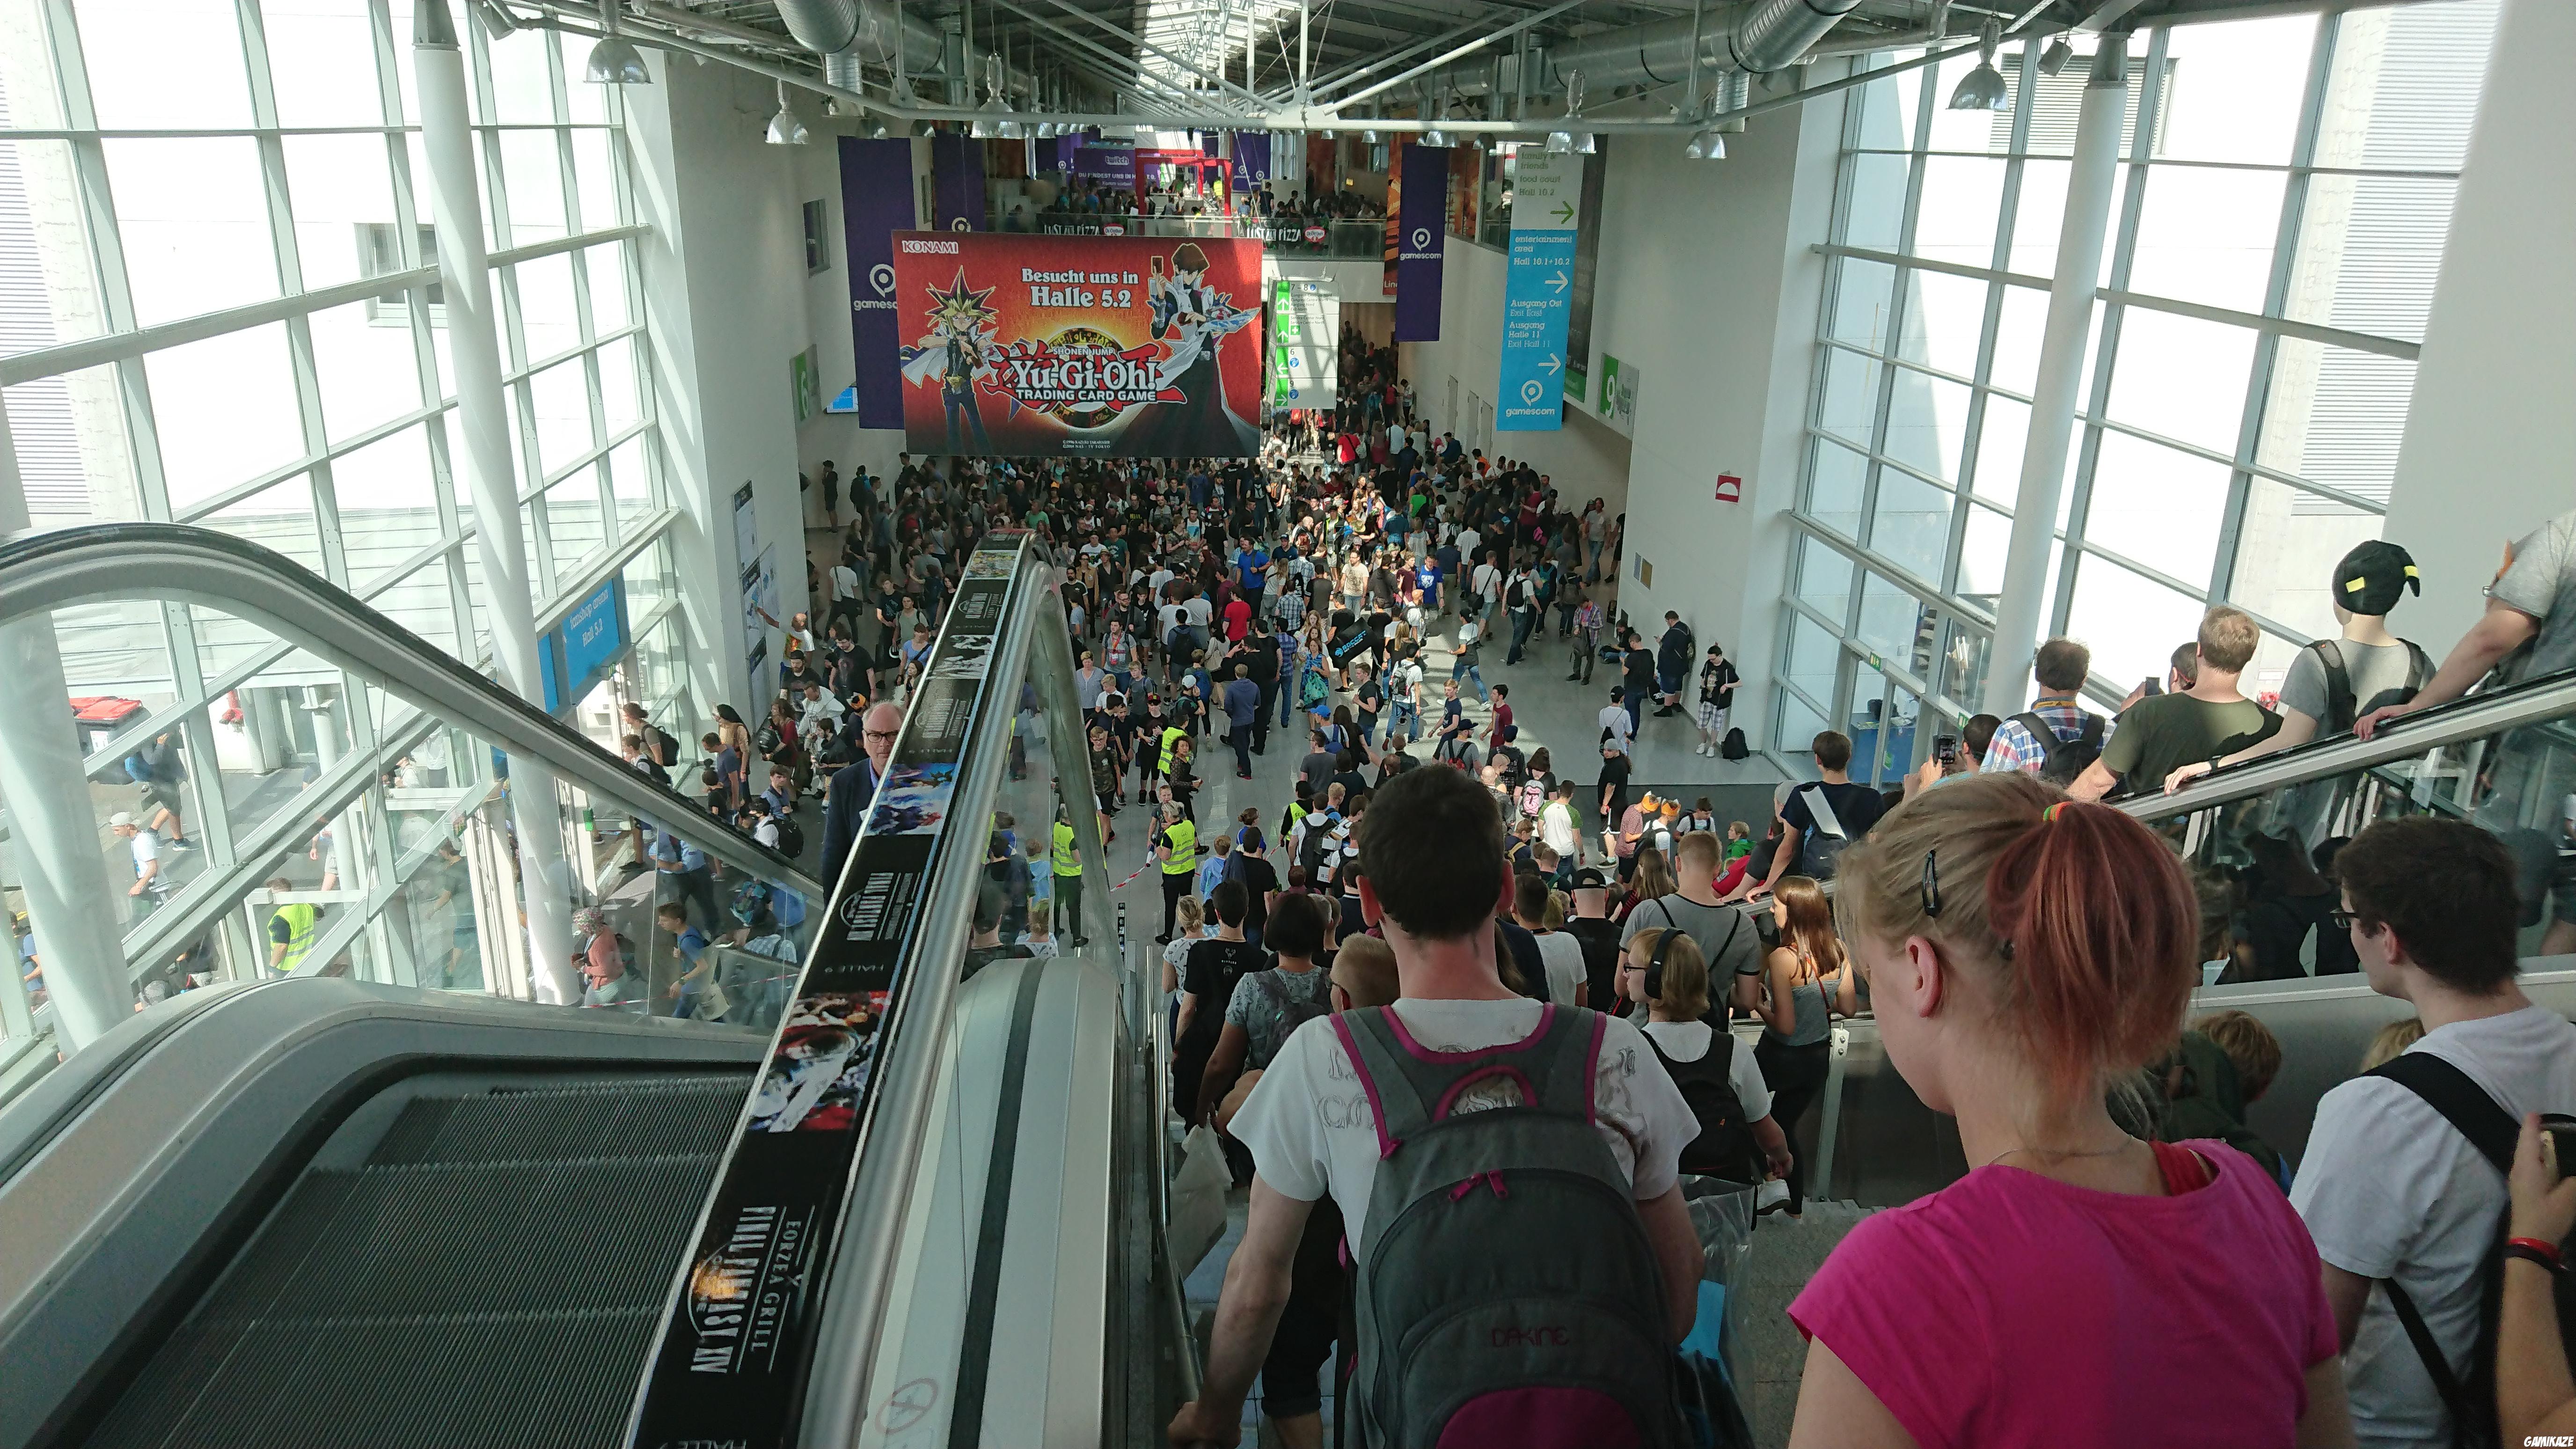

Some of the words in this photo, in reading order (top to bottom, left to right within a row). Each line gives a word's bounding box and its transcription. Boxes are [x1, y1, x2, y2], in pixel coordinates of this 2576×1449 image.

[1105, 155, 1129, 166] twitch
[1279, 227, 1301, 242] PIZZA
[901, 240, 959, 255] KONAMI
[1400, 252, 1442, 261] gamescom
[1021, 268, 1085, 284] Besucht
[1090, 272, 1118, 285] uns
[1122, 271, 1139, 285] in
[1030, 285, 1095, 308] Halle
[1101, 290, 1132, 308] 5.2
[1510, 300, 1547, 308] Ausgang
[853, 300, 898, 311] gamesc
[1509, 322, 1545, 330] Ausgang
[1010, 360, 1158, 390] Yu-Gi-Oh!
[1016, 389, 1075, 401] TRADING
[1078, 389, 1115, 401] CARD
[1118, 390, 1156, 401] GAME
[1605, 374, 1615, 418] 9
[1506, 408, 1555, 417] gamescom
[769, 1220, 801, 1285] EORZEA
[750, 1292, 781, 1352] GRILL
[1492, 1327, 1568, 1347] DAKINE
